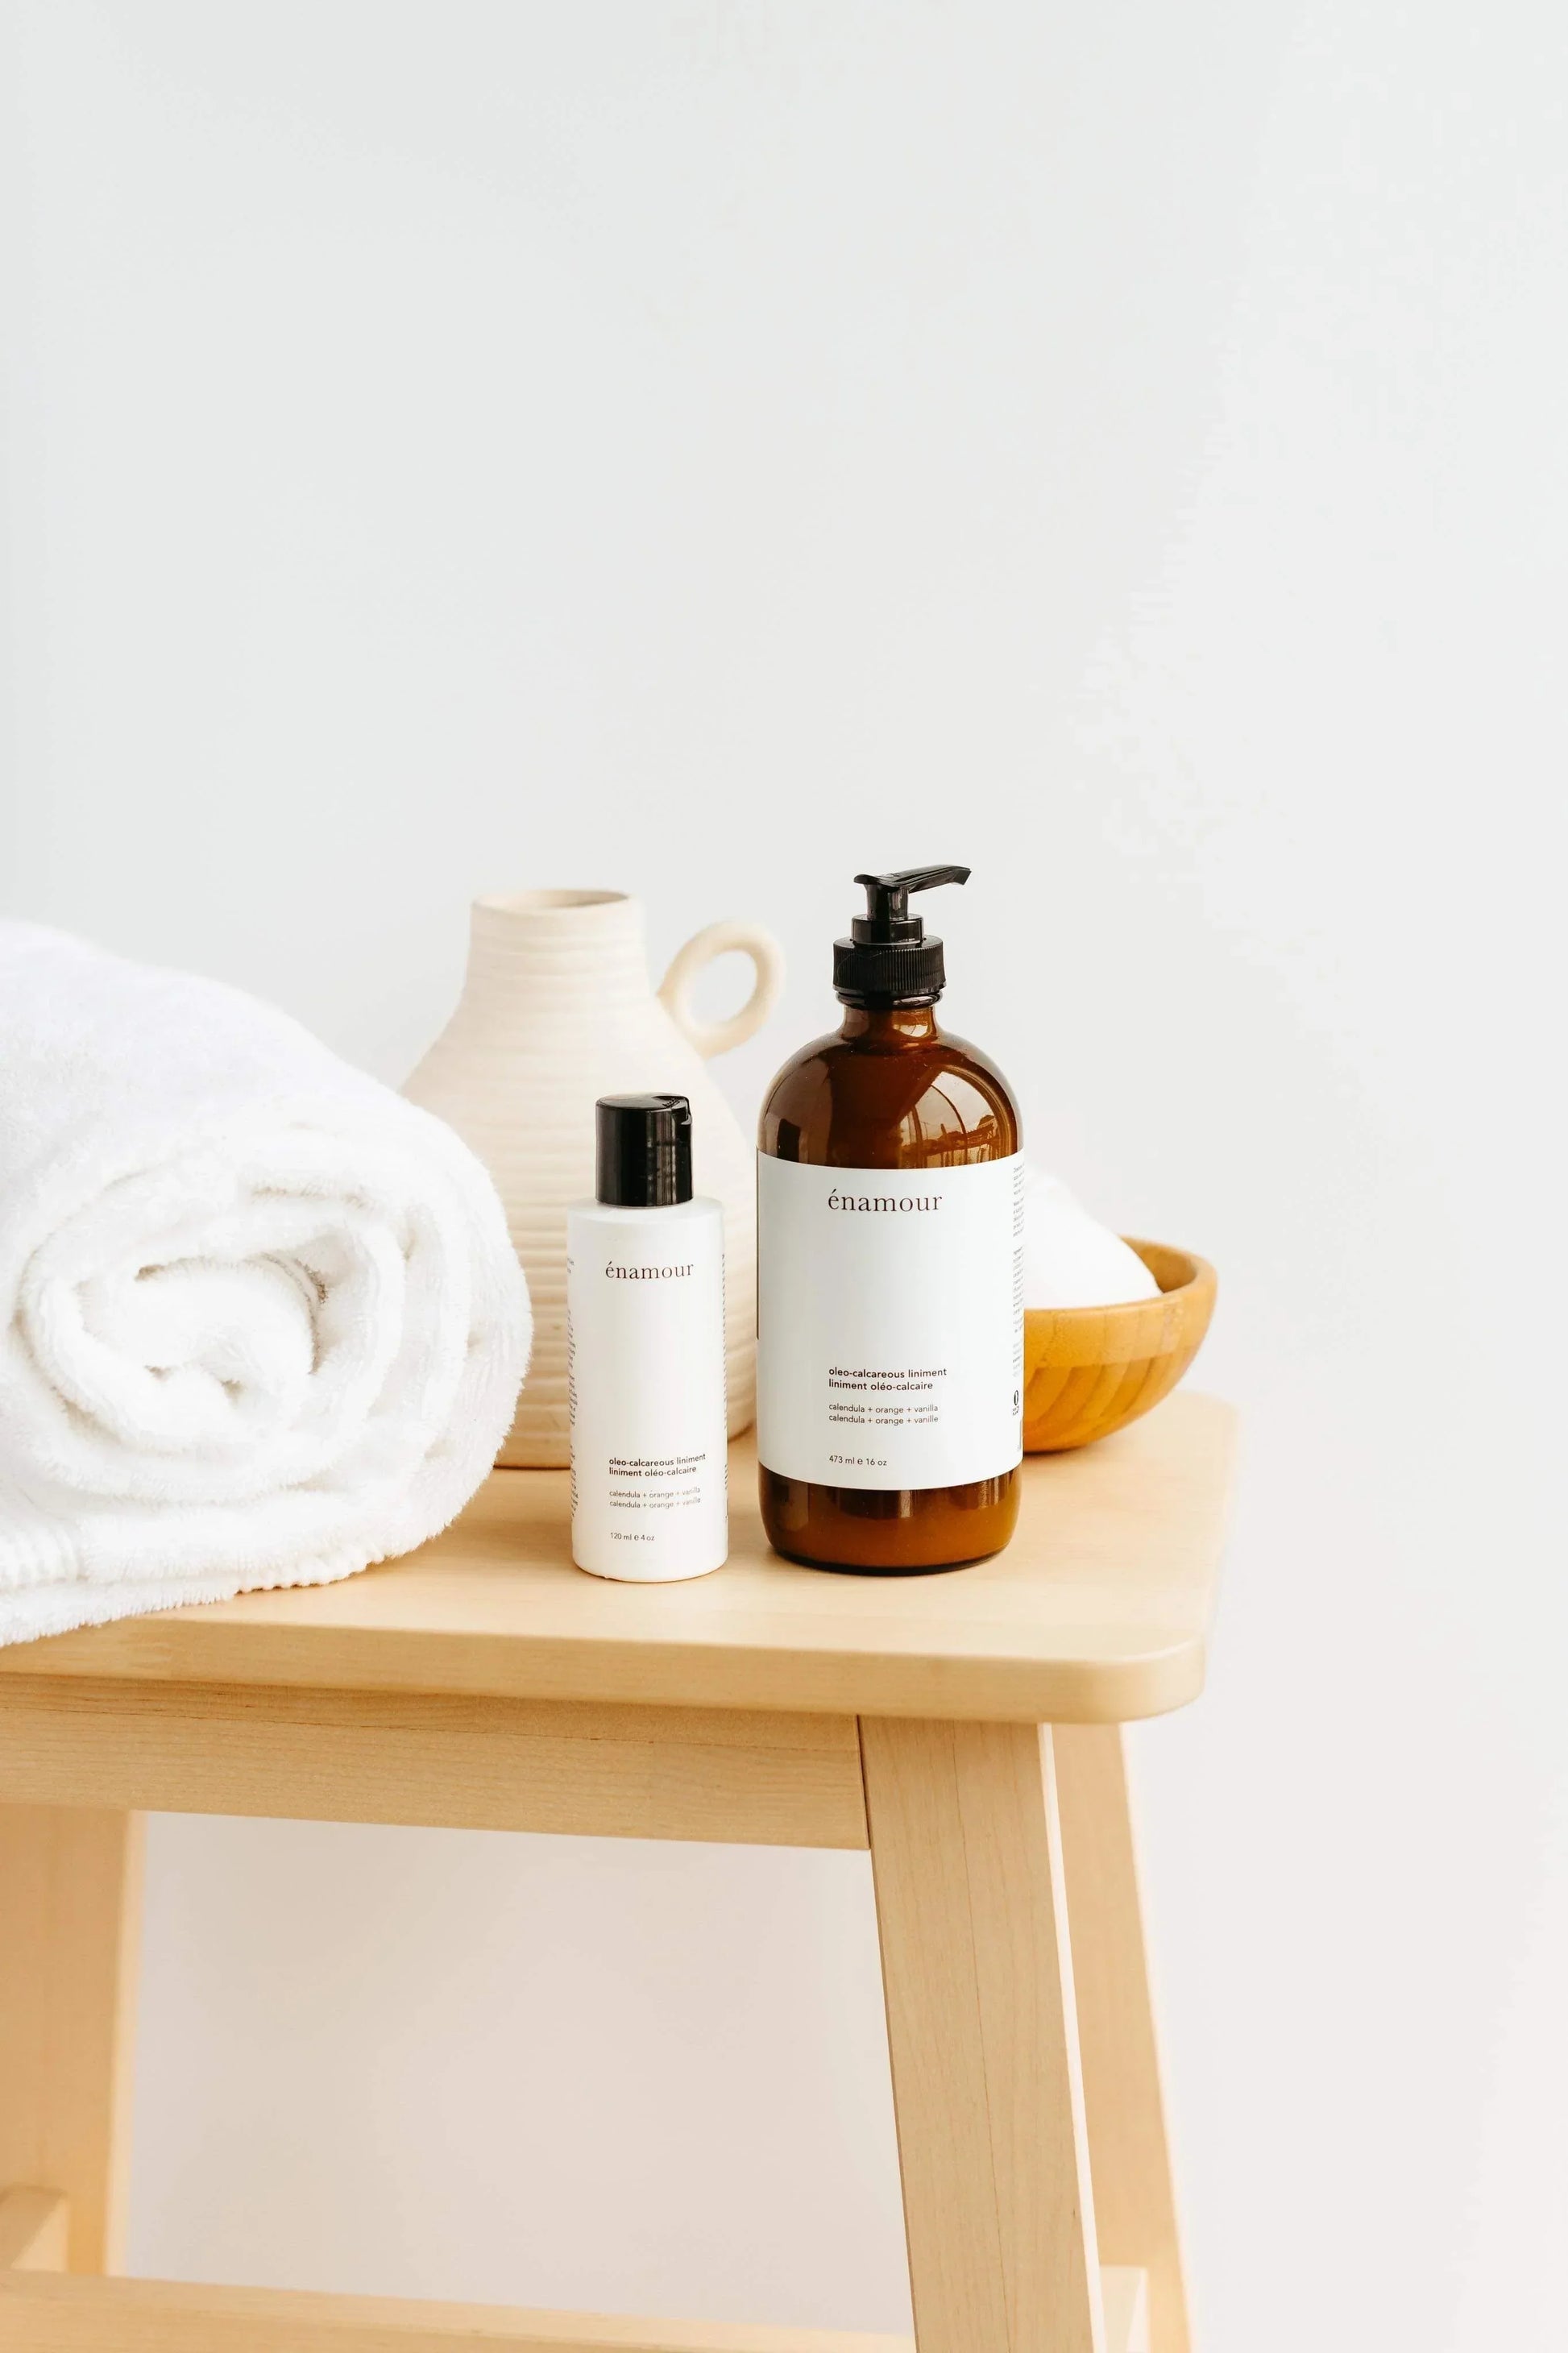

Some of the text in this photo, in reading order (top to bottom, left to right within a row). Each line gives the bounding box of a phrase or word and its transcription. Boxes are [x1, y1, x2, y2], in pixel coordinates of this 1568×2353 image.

[828, 1188, 943, 1213] énamour
[605, 1260, 695, 1280] énamour
[828, 1367, 948, 1379] oleo-calcareous liniment
[828, 1379, 934, 1392] liniment oléo-calcaire
[828, 1402, 865, 1413] calendula
[875, 1406, 904, 1415] orange
[914, 1404, 939, 1413] vanilla
[828, 1413, 865, 1424] calendula
[875, 1417, 904, 1426] orange
[914, 1414, 939, 1424] vanille
[608, 1453, 706, 1467] oleo-calcareous liniment
[828, 1455, 844, 1464] 473
[845, 1456, 855, 1465] ml
[865, 1458, 876, 1467] 16
[608, 1466, 697, 1477] liniment oléo-calcaire
[608, 1489, 641, 1499] calendula
[649, 1492, 674, 1500] orange
[608, 1500, 641, 1509] calendula
[649, 1501, 674, 1509] orange
[610, 1532, 622, 1541] 120
[624, 1533, 632, 1542] ml
